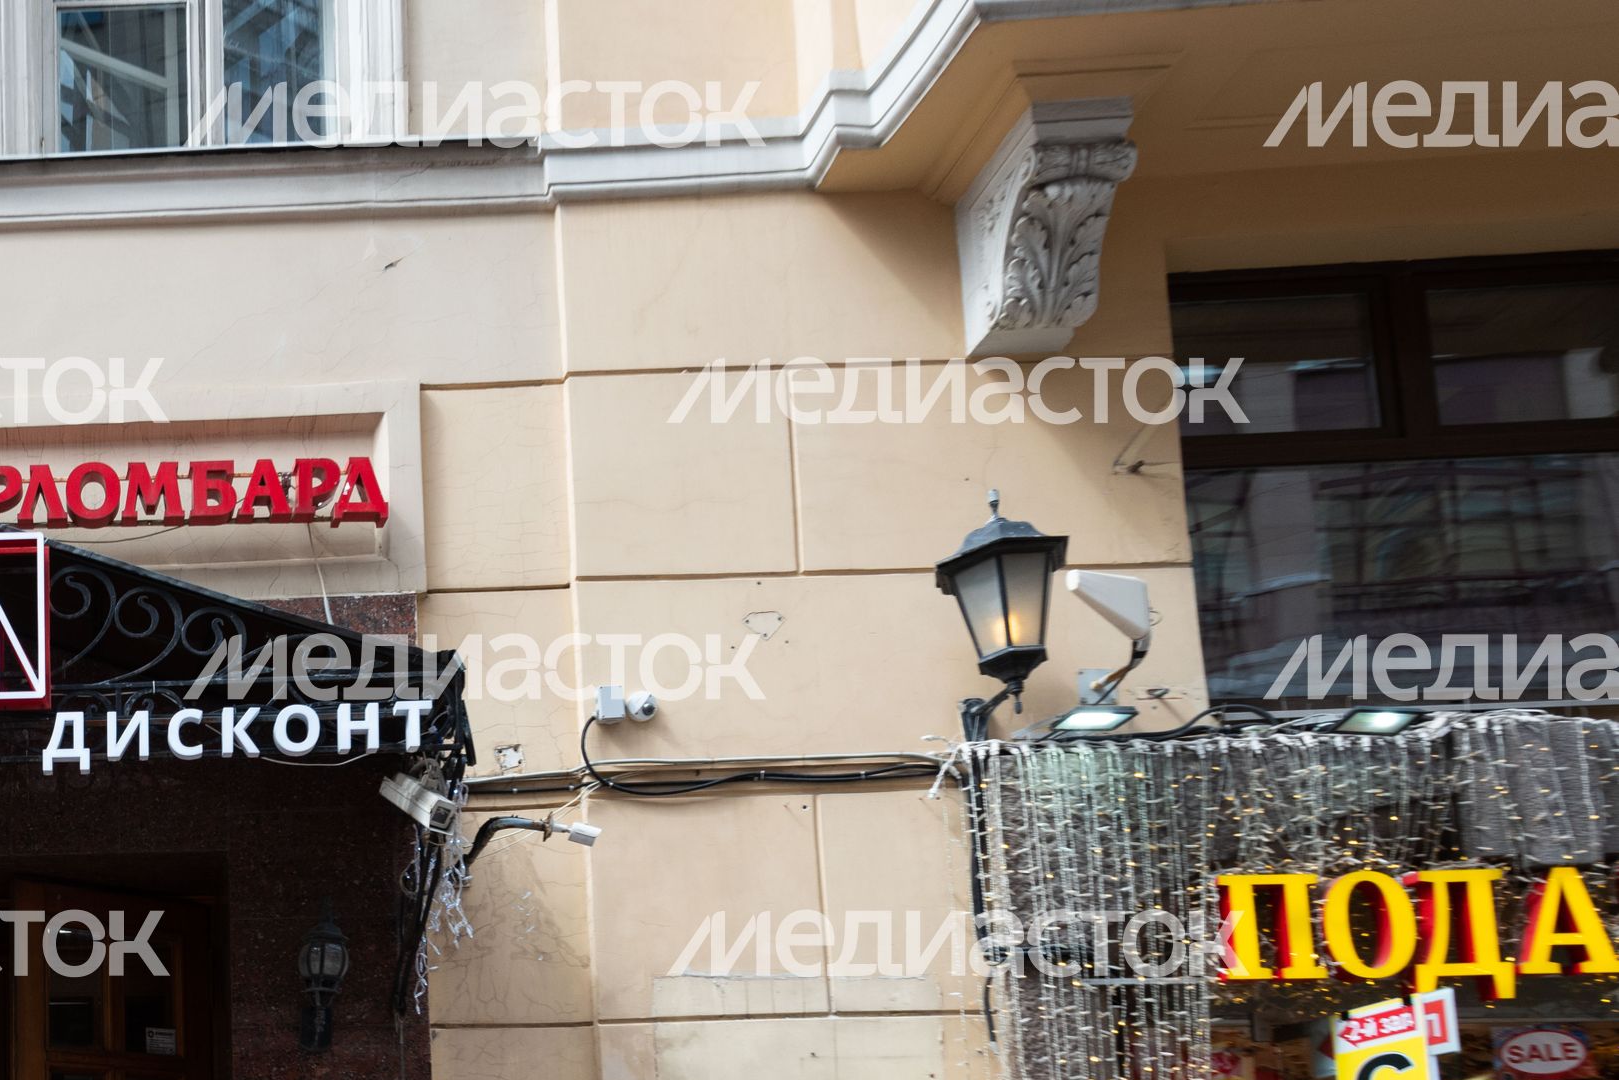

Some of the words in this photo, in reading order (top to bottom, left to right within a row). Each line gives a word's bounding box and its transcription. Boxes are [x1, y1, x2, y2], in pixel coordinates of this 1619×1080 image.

[42, 700, 433, 776] ДИСКОНТ
[1216, 866, 1619, 1000] ПОДА
[1508, 1041, 1579, 1064] SALE
